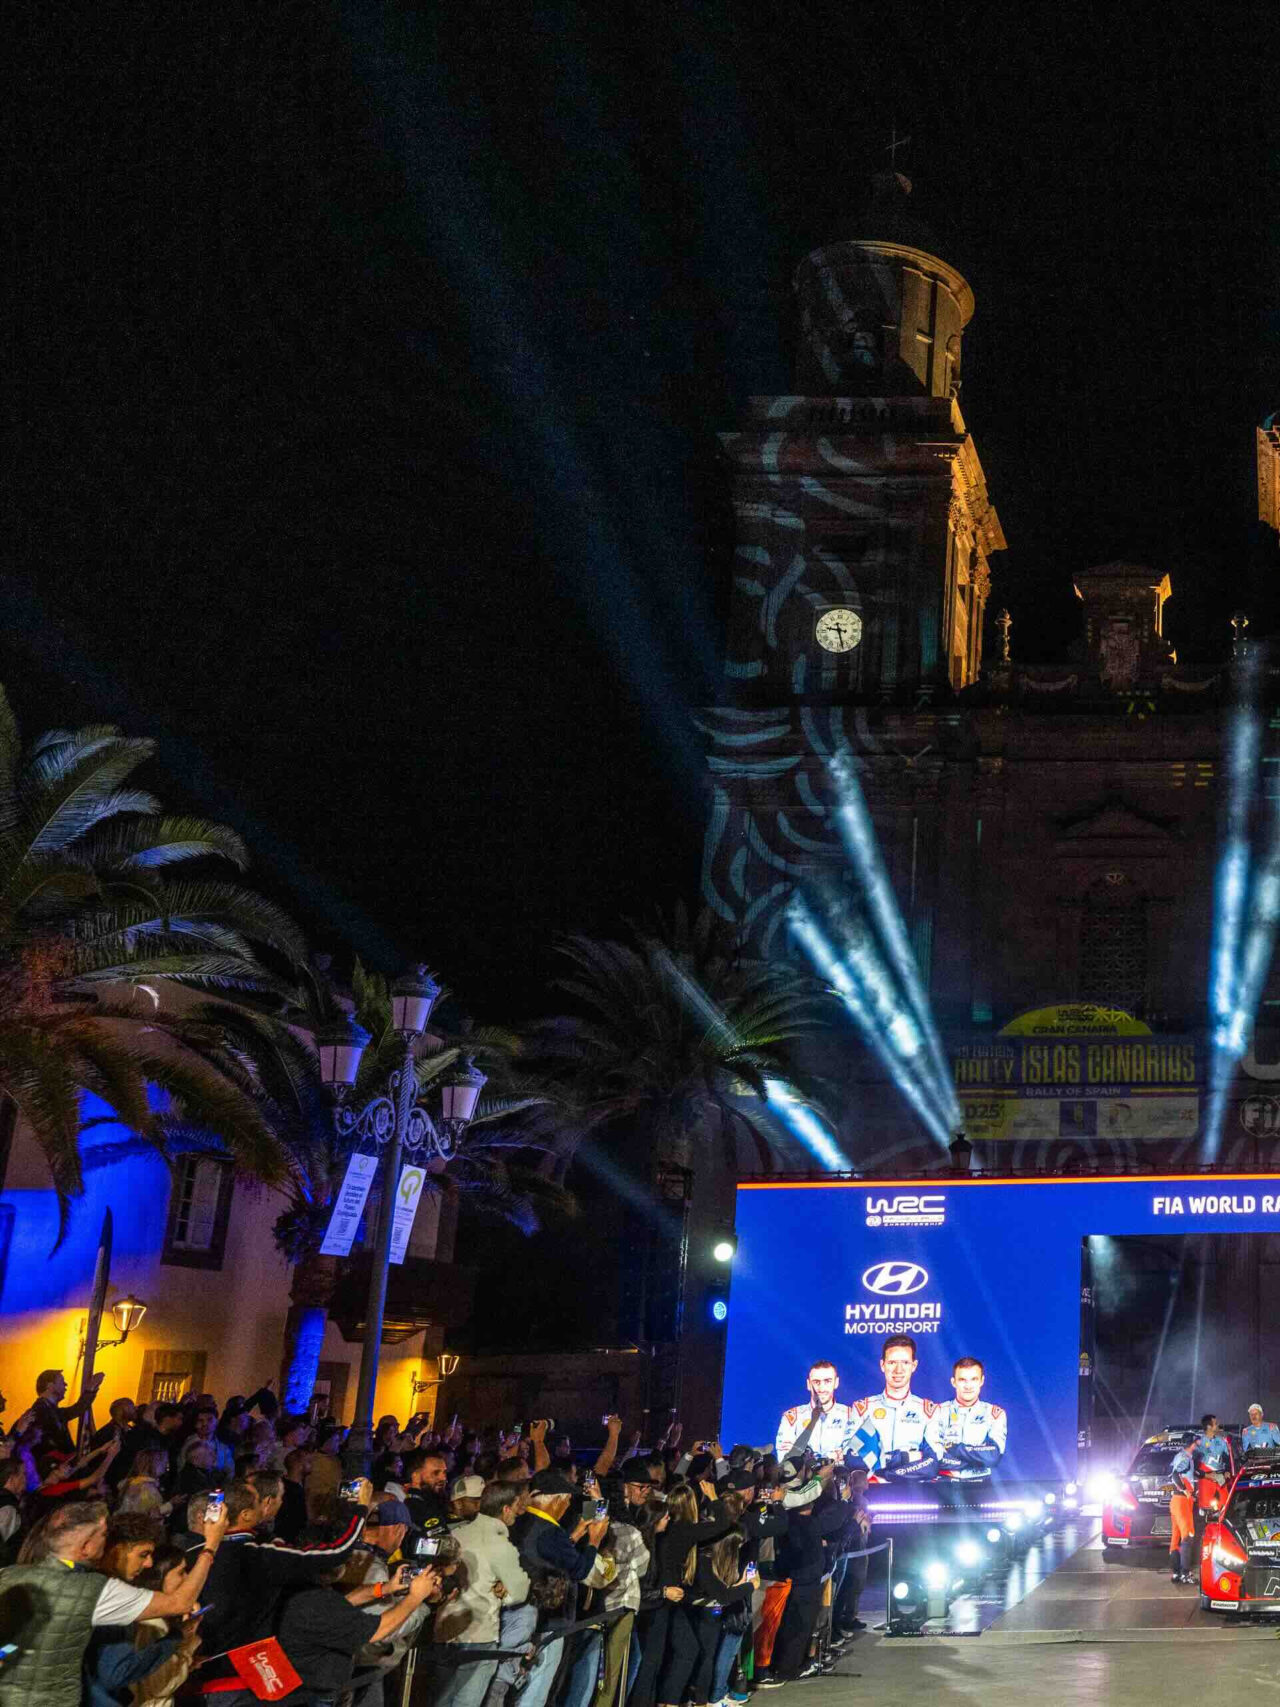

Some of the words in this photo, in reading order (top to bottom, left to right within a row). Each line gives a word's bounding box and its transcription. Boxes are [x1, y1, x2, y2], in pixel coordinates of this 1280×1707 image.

[1021, 1044, 1081, 1084] ISLAS
[1087, 1043, 1196, 1084] CANARIAS
[1026, 1087, 1062, 1097] RALLY
[1065, 1087, 1083, 1097] OF
[1085, 1086, 1122, 1096] SPAIN
[866, 1195, 946, 1214] WRC
[1152, 1197, 1185, 1215] FIA
[1188, 1195, 1256, 1214] WORLD
[844, 1302, 942, 1320] HYUNDAI
[844, 1321, 941, 1335] MOTORSPORT
[906, 1457, 934, 1473] HYUNDAI
[256, 1651, 284, 1693] WRC
